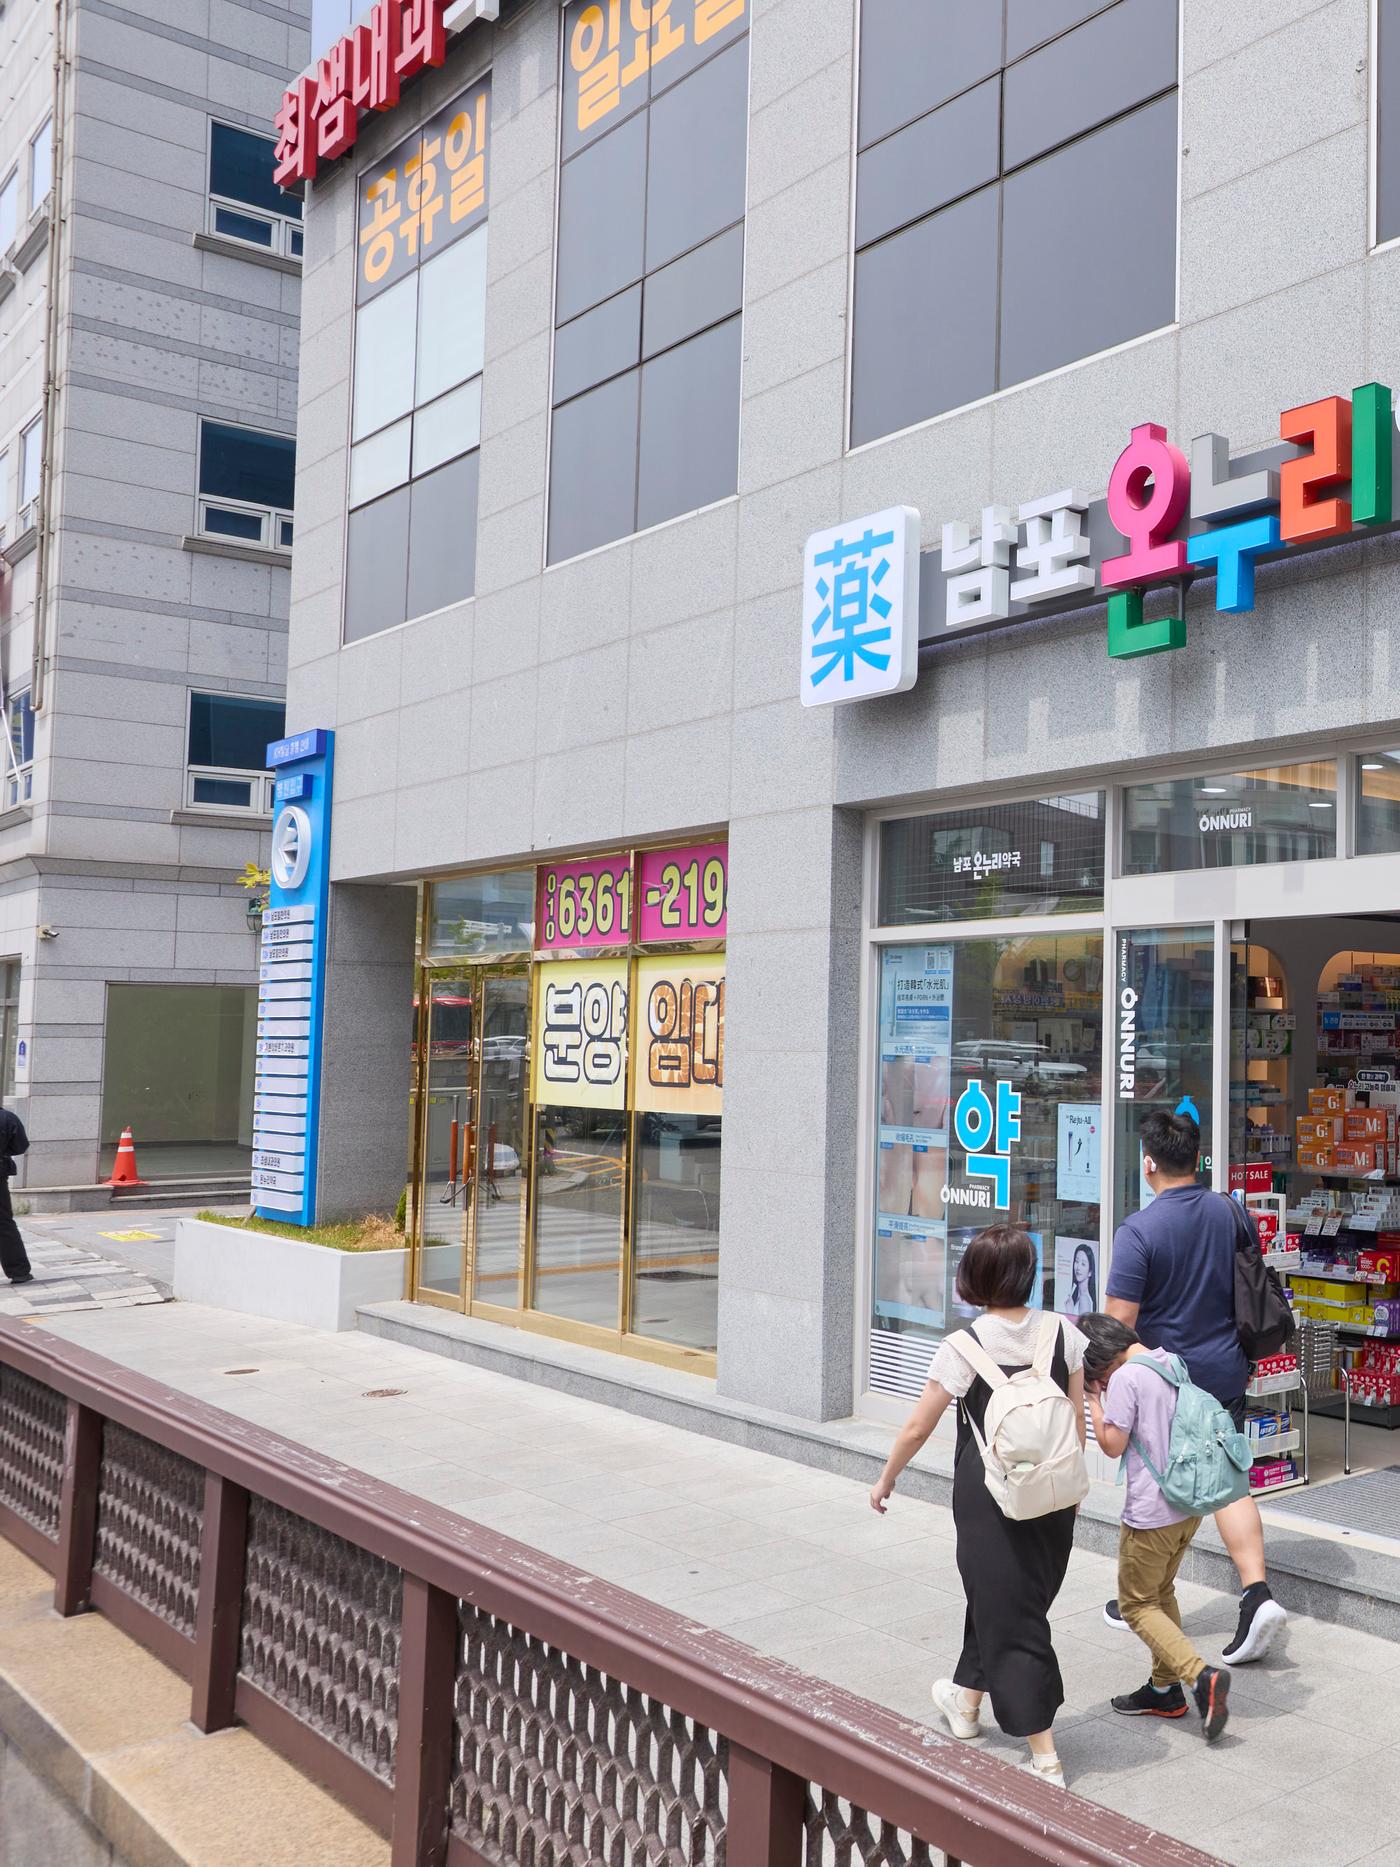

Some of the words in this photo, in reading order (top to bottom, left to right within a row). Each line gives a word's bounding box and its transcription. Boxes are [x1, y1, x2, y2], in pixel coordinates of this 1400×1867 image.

[273, 0, 499, 186] 최샘내과
[360, 93, 487, 283] 공휴일
[942, 484, 1095, 626] 남포
[953, 857, 971, 873] 남포
[1199, 812, 1252, 832] ONNURI
[647, 856, 728, 929] -219
[543, 982, 628, 1085] 분양
[1120, 987, 1138, 1099] ONNURI
[940, 1184, 990, 1208] ONNURI
[954, 1079, 1021, 1211] 약
[1231, 1171, 1248, 1181] HOT
[1250, 1170, 1269, 1180] SALE
